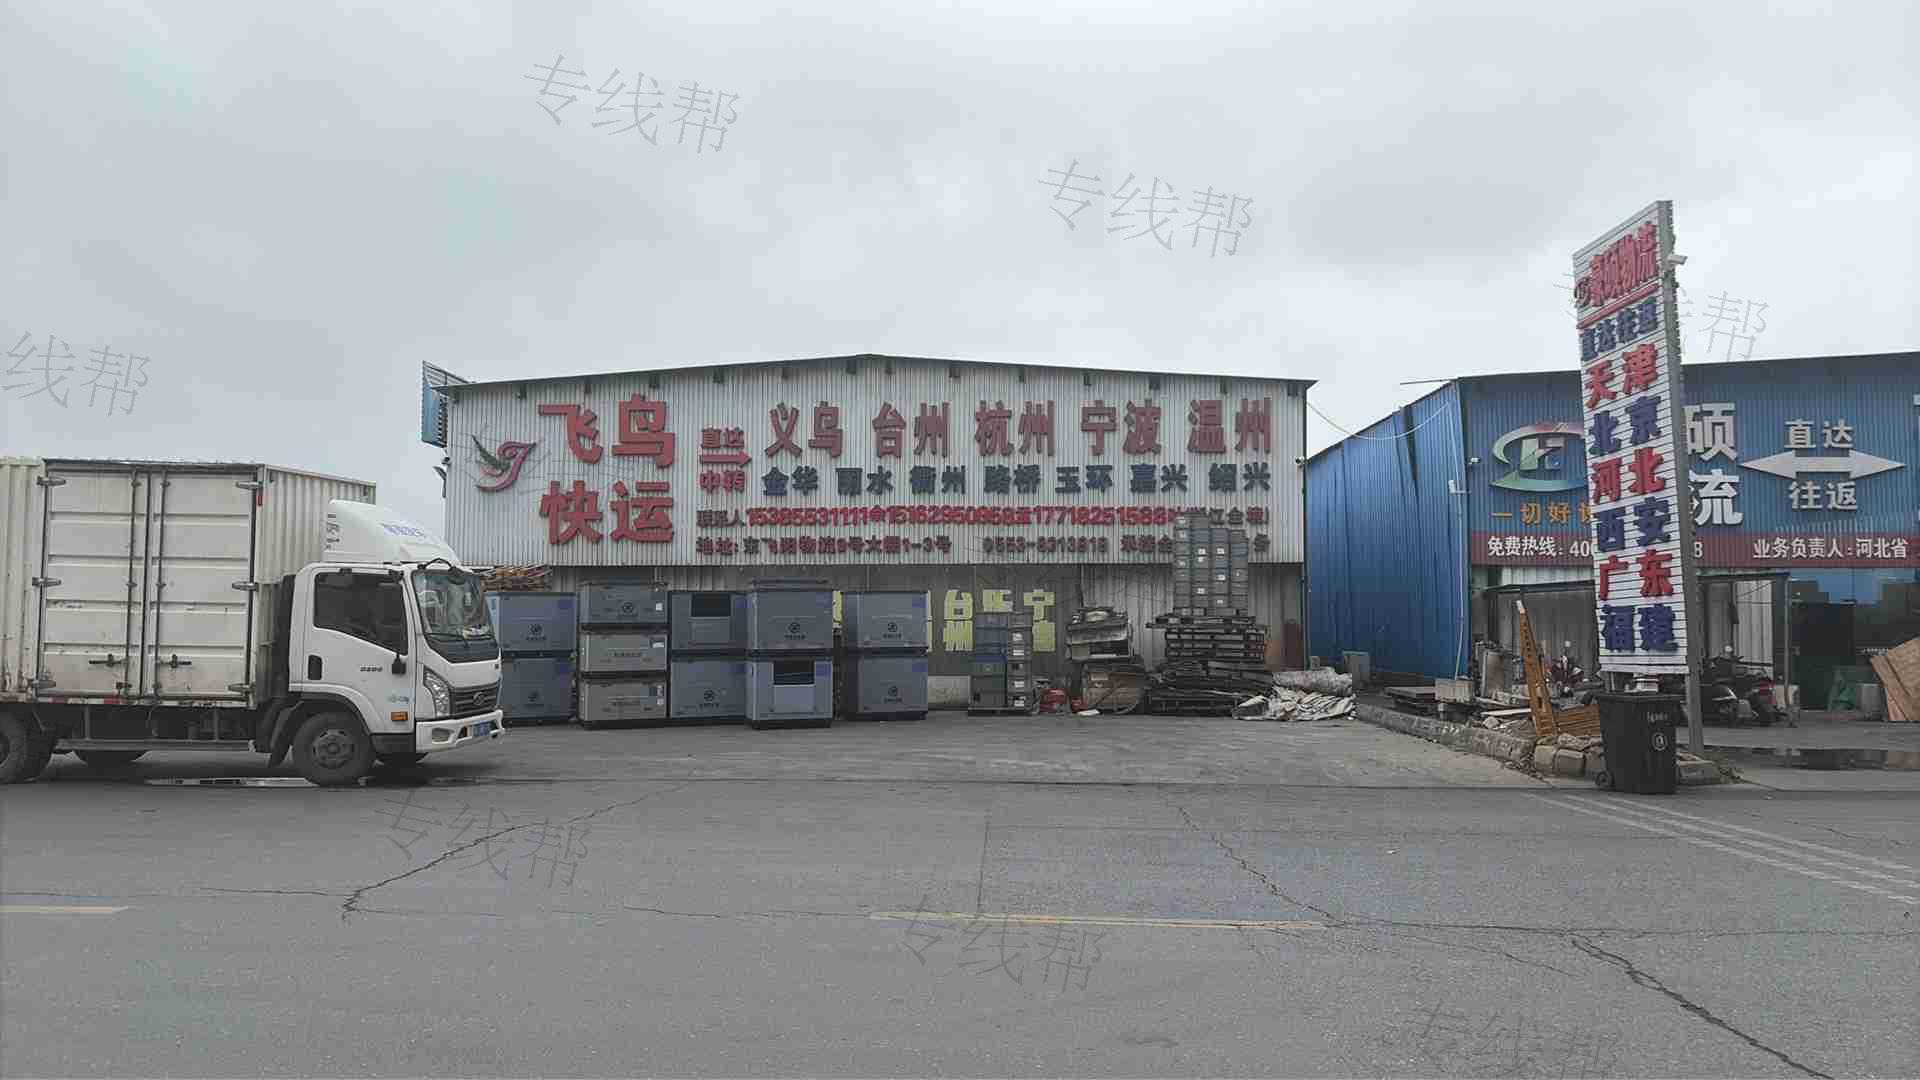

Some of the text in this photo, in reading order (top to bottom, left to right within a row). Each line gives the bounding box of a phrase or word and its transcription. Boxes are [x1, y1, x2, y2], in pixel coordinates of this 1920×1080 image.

[1580, 296, 1657, 364] 直达往返
[1585, 343, 1658, 410] 天津
[538, 393, 675, 468] 飞鸟
[701, 426, 745, 449] 直达
[765, 398, 1271, 458] 义乌 台州 杭州 宁波 温州
[1588, 396, 1662, 456] 北京
[1784, 419, 1853, 449] 直达
[699, 470, 746, 495] 中转
[762, 465, 819, 496] 金华
[910, 465, 966, 495] 衢州
[984, 464, 1041, 495] 路桥
[1056, 464, 1113, 494] 玉环
[1130, 463, 1188, 493] 嘉兴
[1208, 462, 1270, 492] 绍兴
[1591, 447, 1667, 505] 河北
[1789, 481, 1858, 511] 往返
[538, 480, 675, 545] 快运
[1593, 497, 1671, 552] 西安
[1598, 549, 1674, 601] 广东
[1600, 604, 1679, 652] 福建
